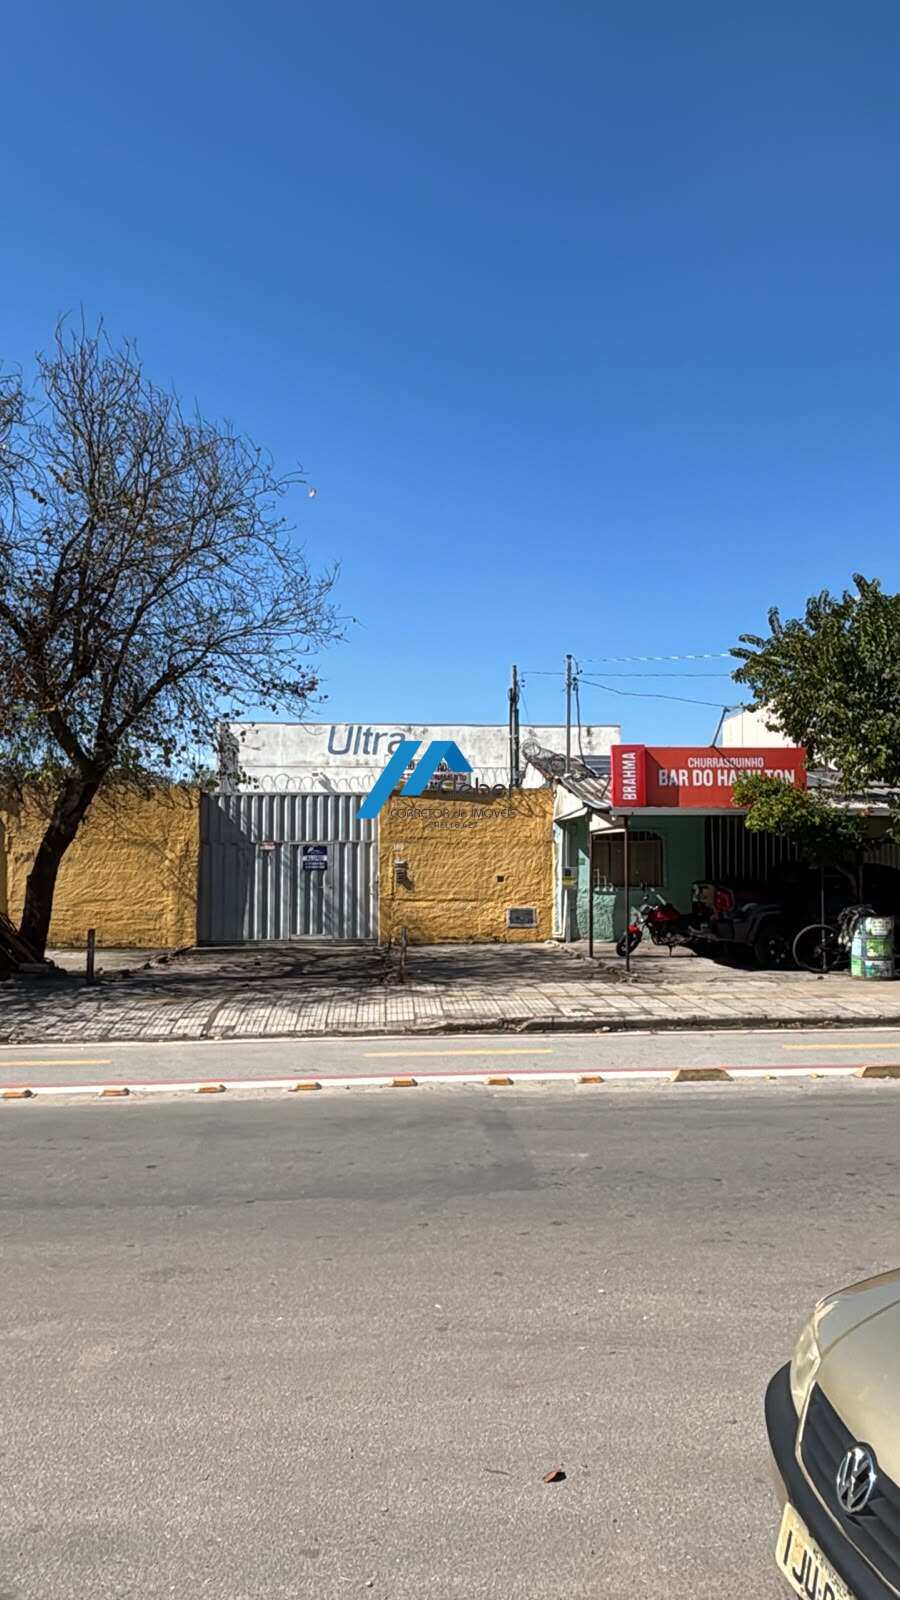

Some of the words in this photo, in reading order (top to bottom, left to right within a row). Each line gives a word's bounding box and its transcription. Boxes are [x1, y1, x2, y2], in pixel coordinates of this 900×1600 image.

[687, 757, 764, 768] CHURRASQUINHO
[622, 752, 637, 800] BRAHMA
[658, 769, 688, 786] BAR
[692, 769, 713, 787] DO
